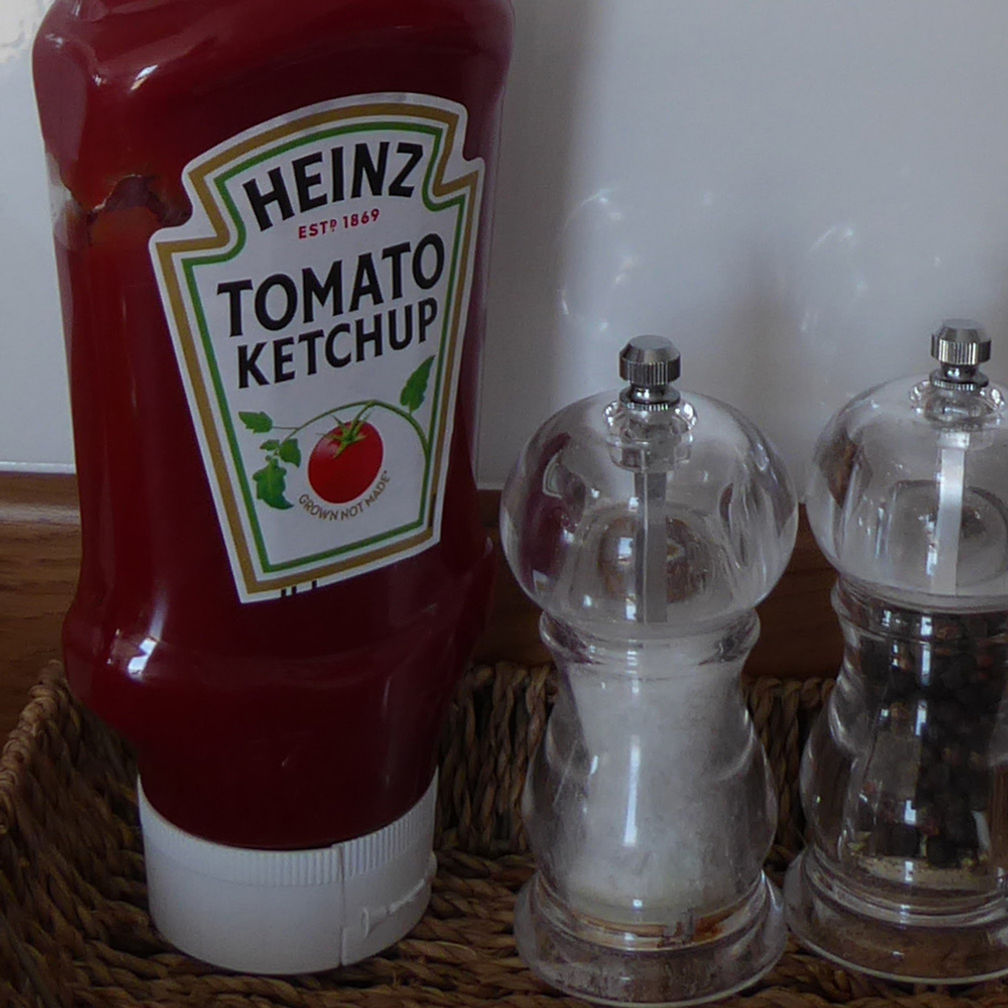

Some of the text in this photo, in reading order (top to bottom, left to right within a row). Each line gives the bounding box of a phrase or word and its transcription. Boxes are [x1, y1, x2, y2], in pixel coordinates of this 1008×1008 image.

[242, 141, 423, 232] HEINZ
[343, 208, 380, 229] 1869
[216, 233, 445, 337] TOMATO
[236, 297, 438, 389] KETCHUP
[299, 494, 338, 521] GROWN
[340, 502, 364, 521] NOT
